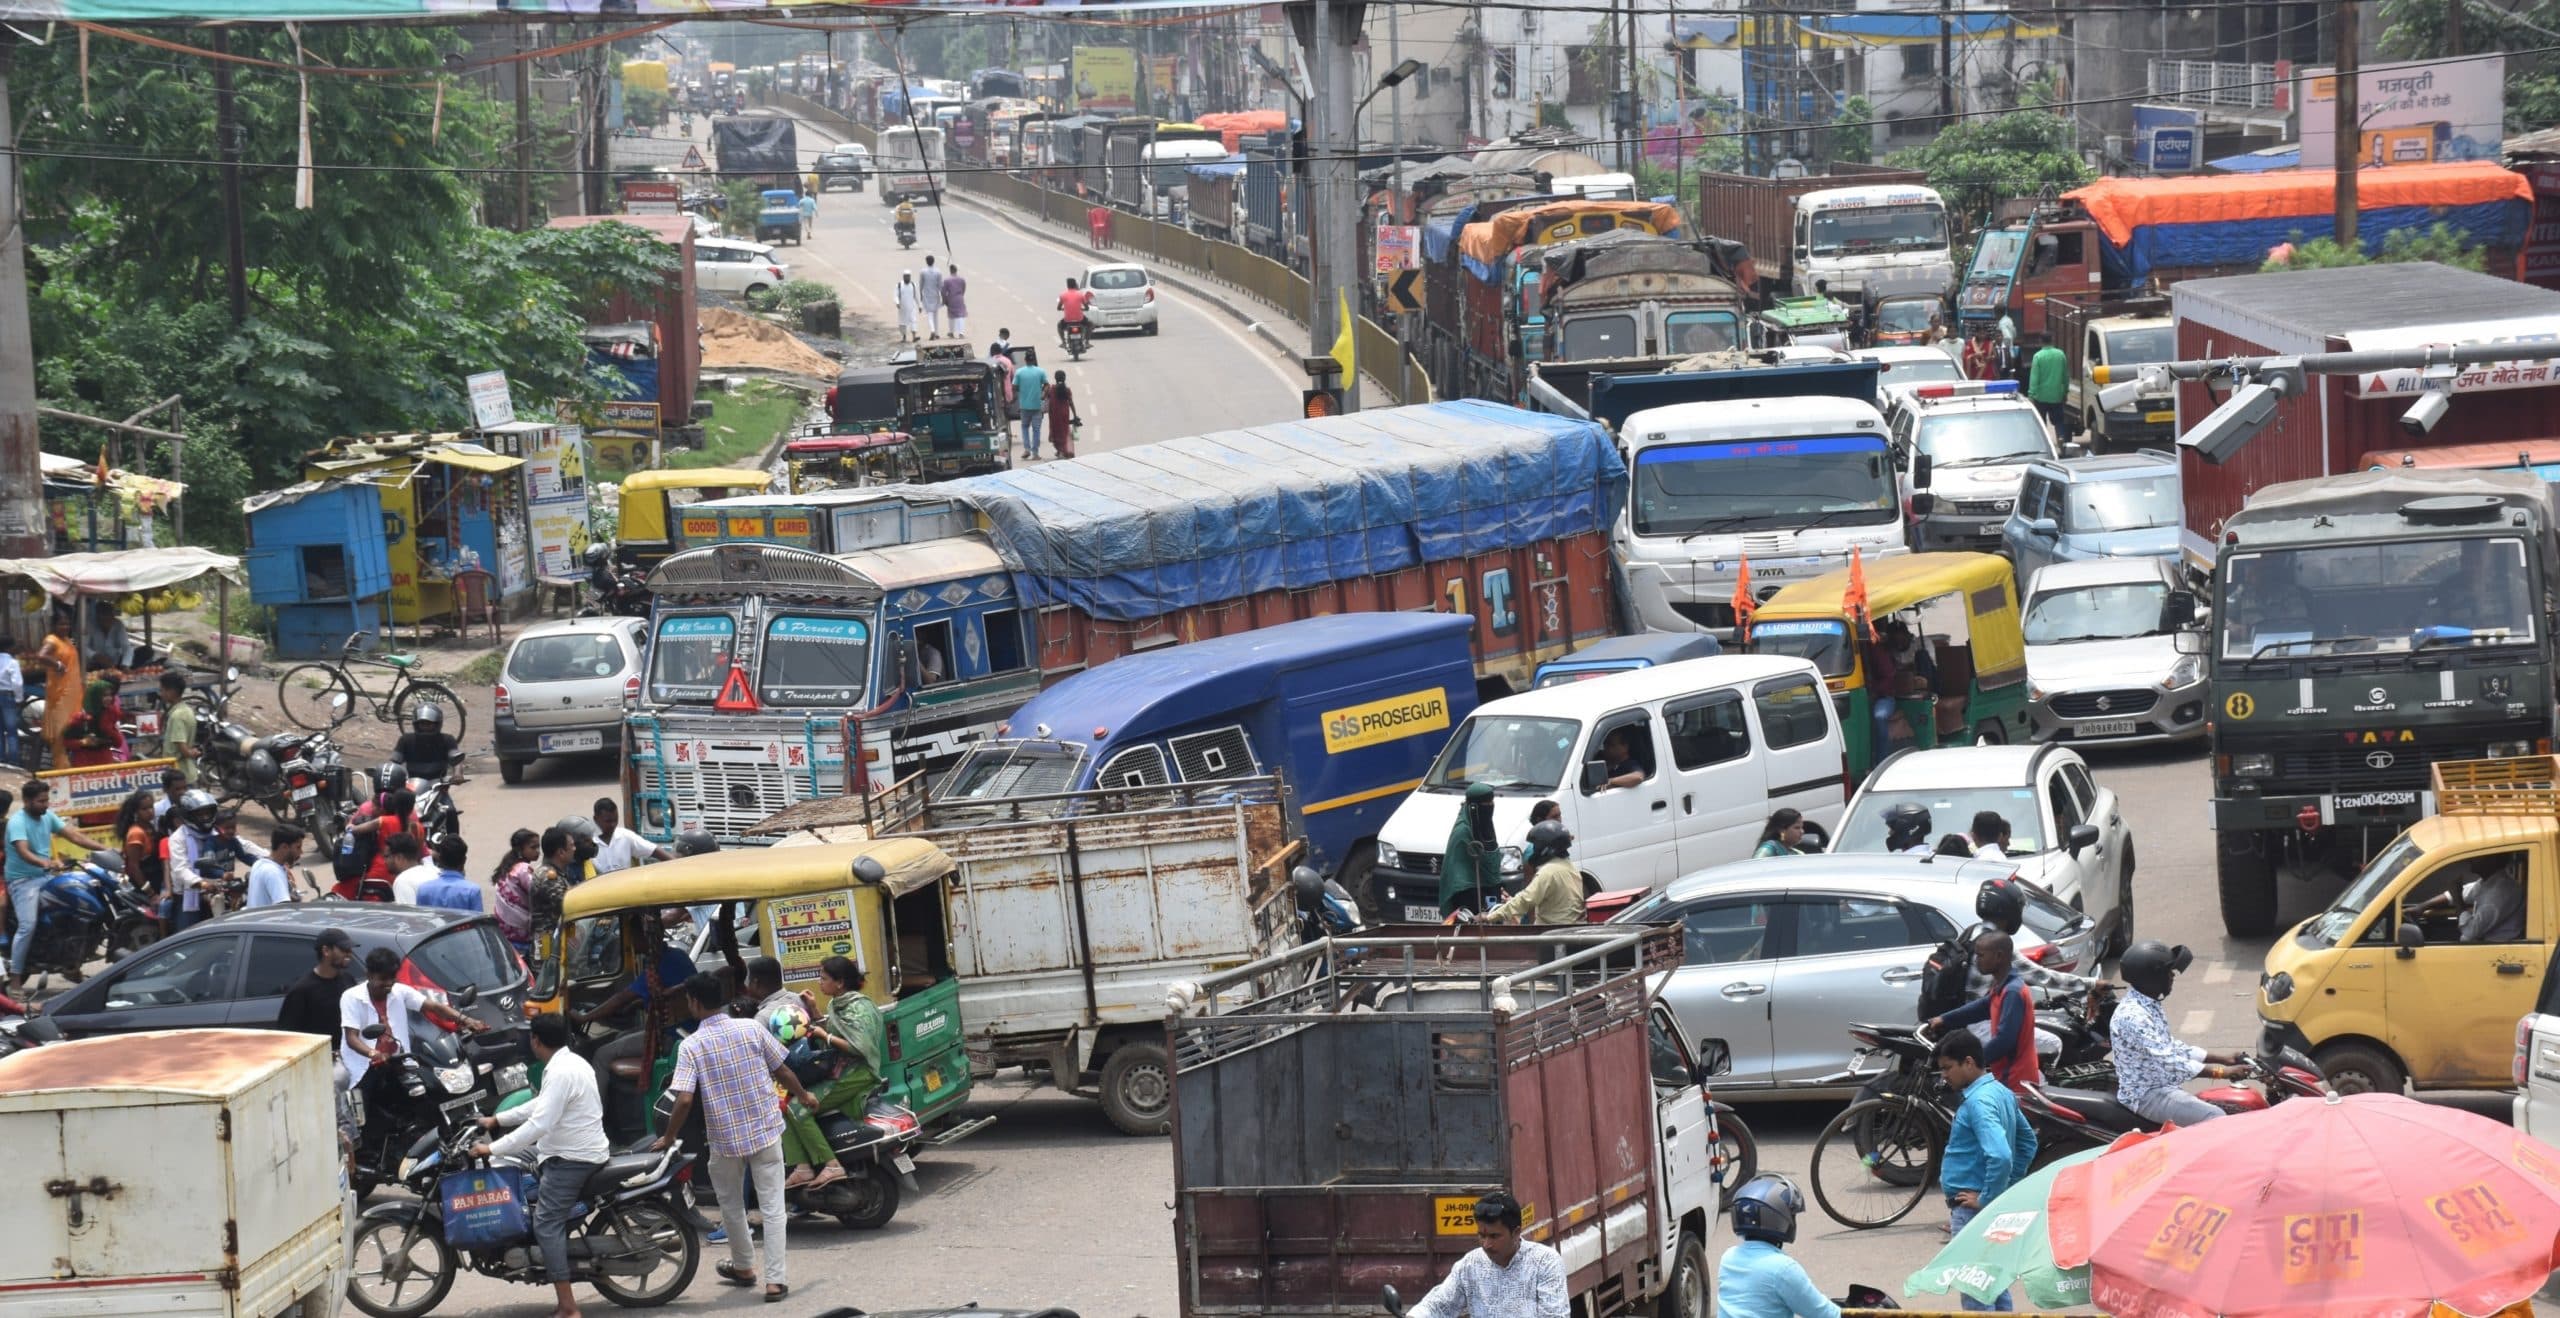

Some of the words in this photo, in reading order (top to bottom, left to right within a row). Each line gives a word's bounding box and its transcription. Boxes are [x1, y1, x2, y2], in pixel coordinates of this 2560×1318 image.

[2377, 70, 2434, 96] मजबूती
[2157, 137, 2190, 151] एटीएम
[2396, 377, 2417, 392] ALL
[2457, 371, 2488, 388] जय
[2522, 366, 2549, 382] नाथ
[688, 522, 717, 533] GOODS
[778, 521, 807, 533] CARRIER
[1756, 568, 1786, 577] TATA
[676, 621, 692, 632] All
[693, 622, 715, 632] India
[791, 622, 844, 635] Permit
[668, 689, 710, 698] Jaiswal
[785, 690, 838, 701] Transport
[2231, 694, 2249, 716] 8
[1362, 700, 1443, 732] PROSEGUR
[2344, 730, 2414, 744] TATA
[72, 771, 122, 793] बोकारो
[781, 908, 846, 927] I.T.I.
[787, 934, 851, 947] ELECTRICIAN
[788, 945, 821, 954] FITTER
[916, 1015, 945, 1035] Maxima
[454, 1196, 474, 1210] PAN
[477, 1190, 510, 1205] PARAG
[2435, 1184, 2499, 1221] CITI
[2173, 1202, 2227, 1236] CITI
[2290, 1213, 2359, 1243] CITI
